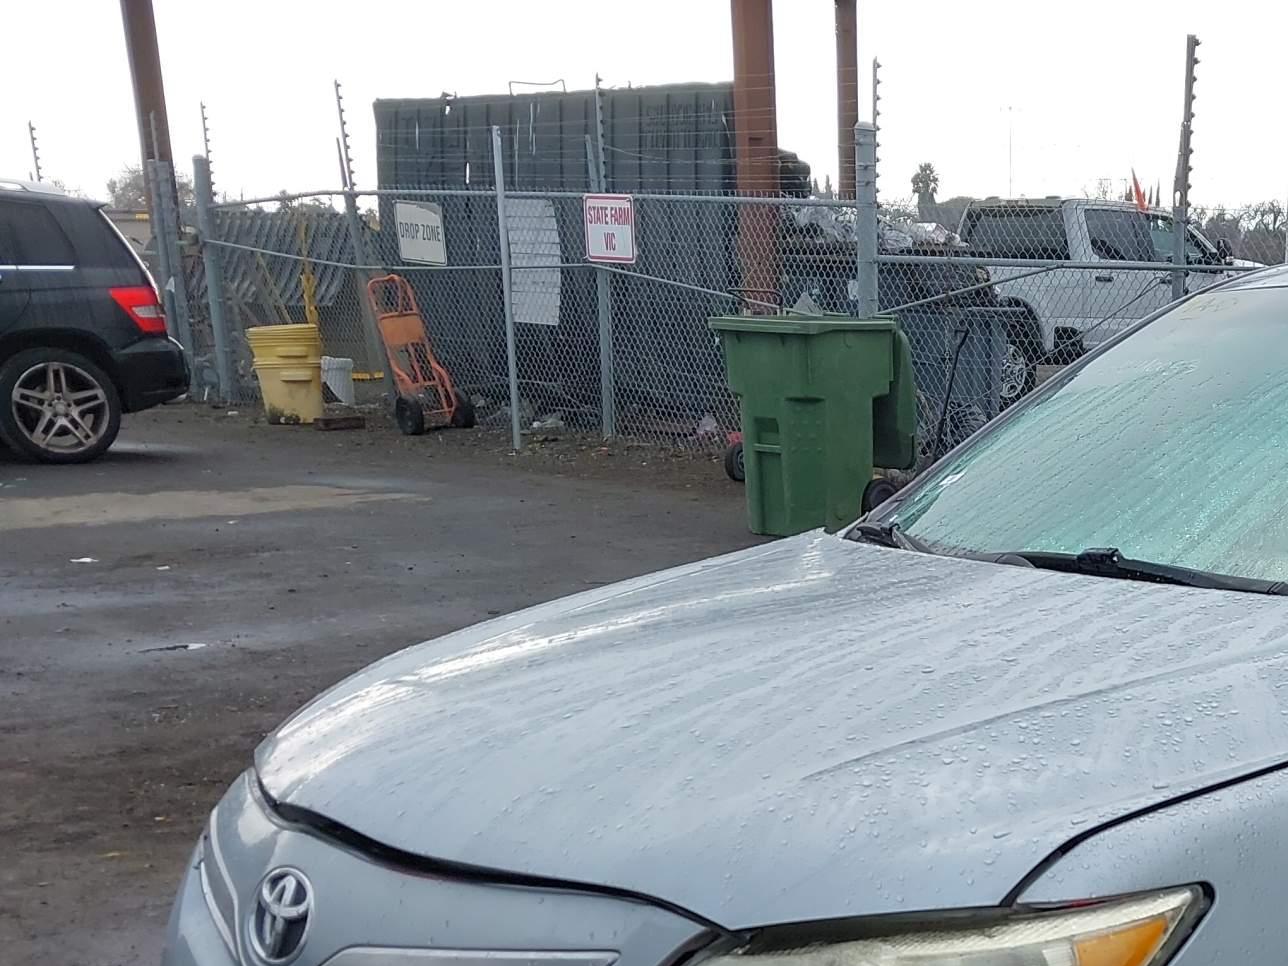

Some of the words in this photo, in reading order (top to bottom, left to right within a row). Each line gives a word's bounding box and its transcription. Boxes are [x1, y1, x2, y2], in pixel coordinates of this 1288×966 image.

[588, 206, 608, 225] STATE
[610, 207, 630, 225] FARM
[399, 222, 419, 240] DROP
[421, 223, 441, 242] ZONE
[603, 232, 616, 251] VIC
